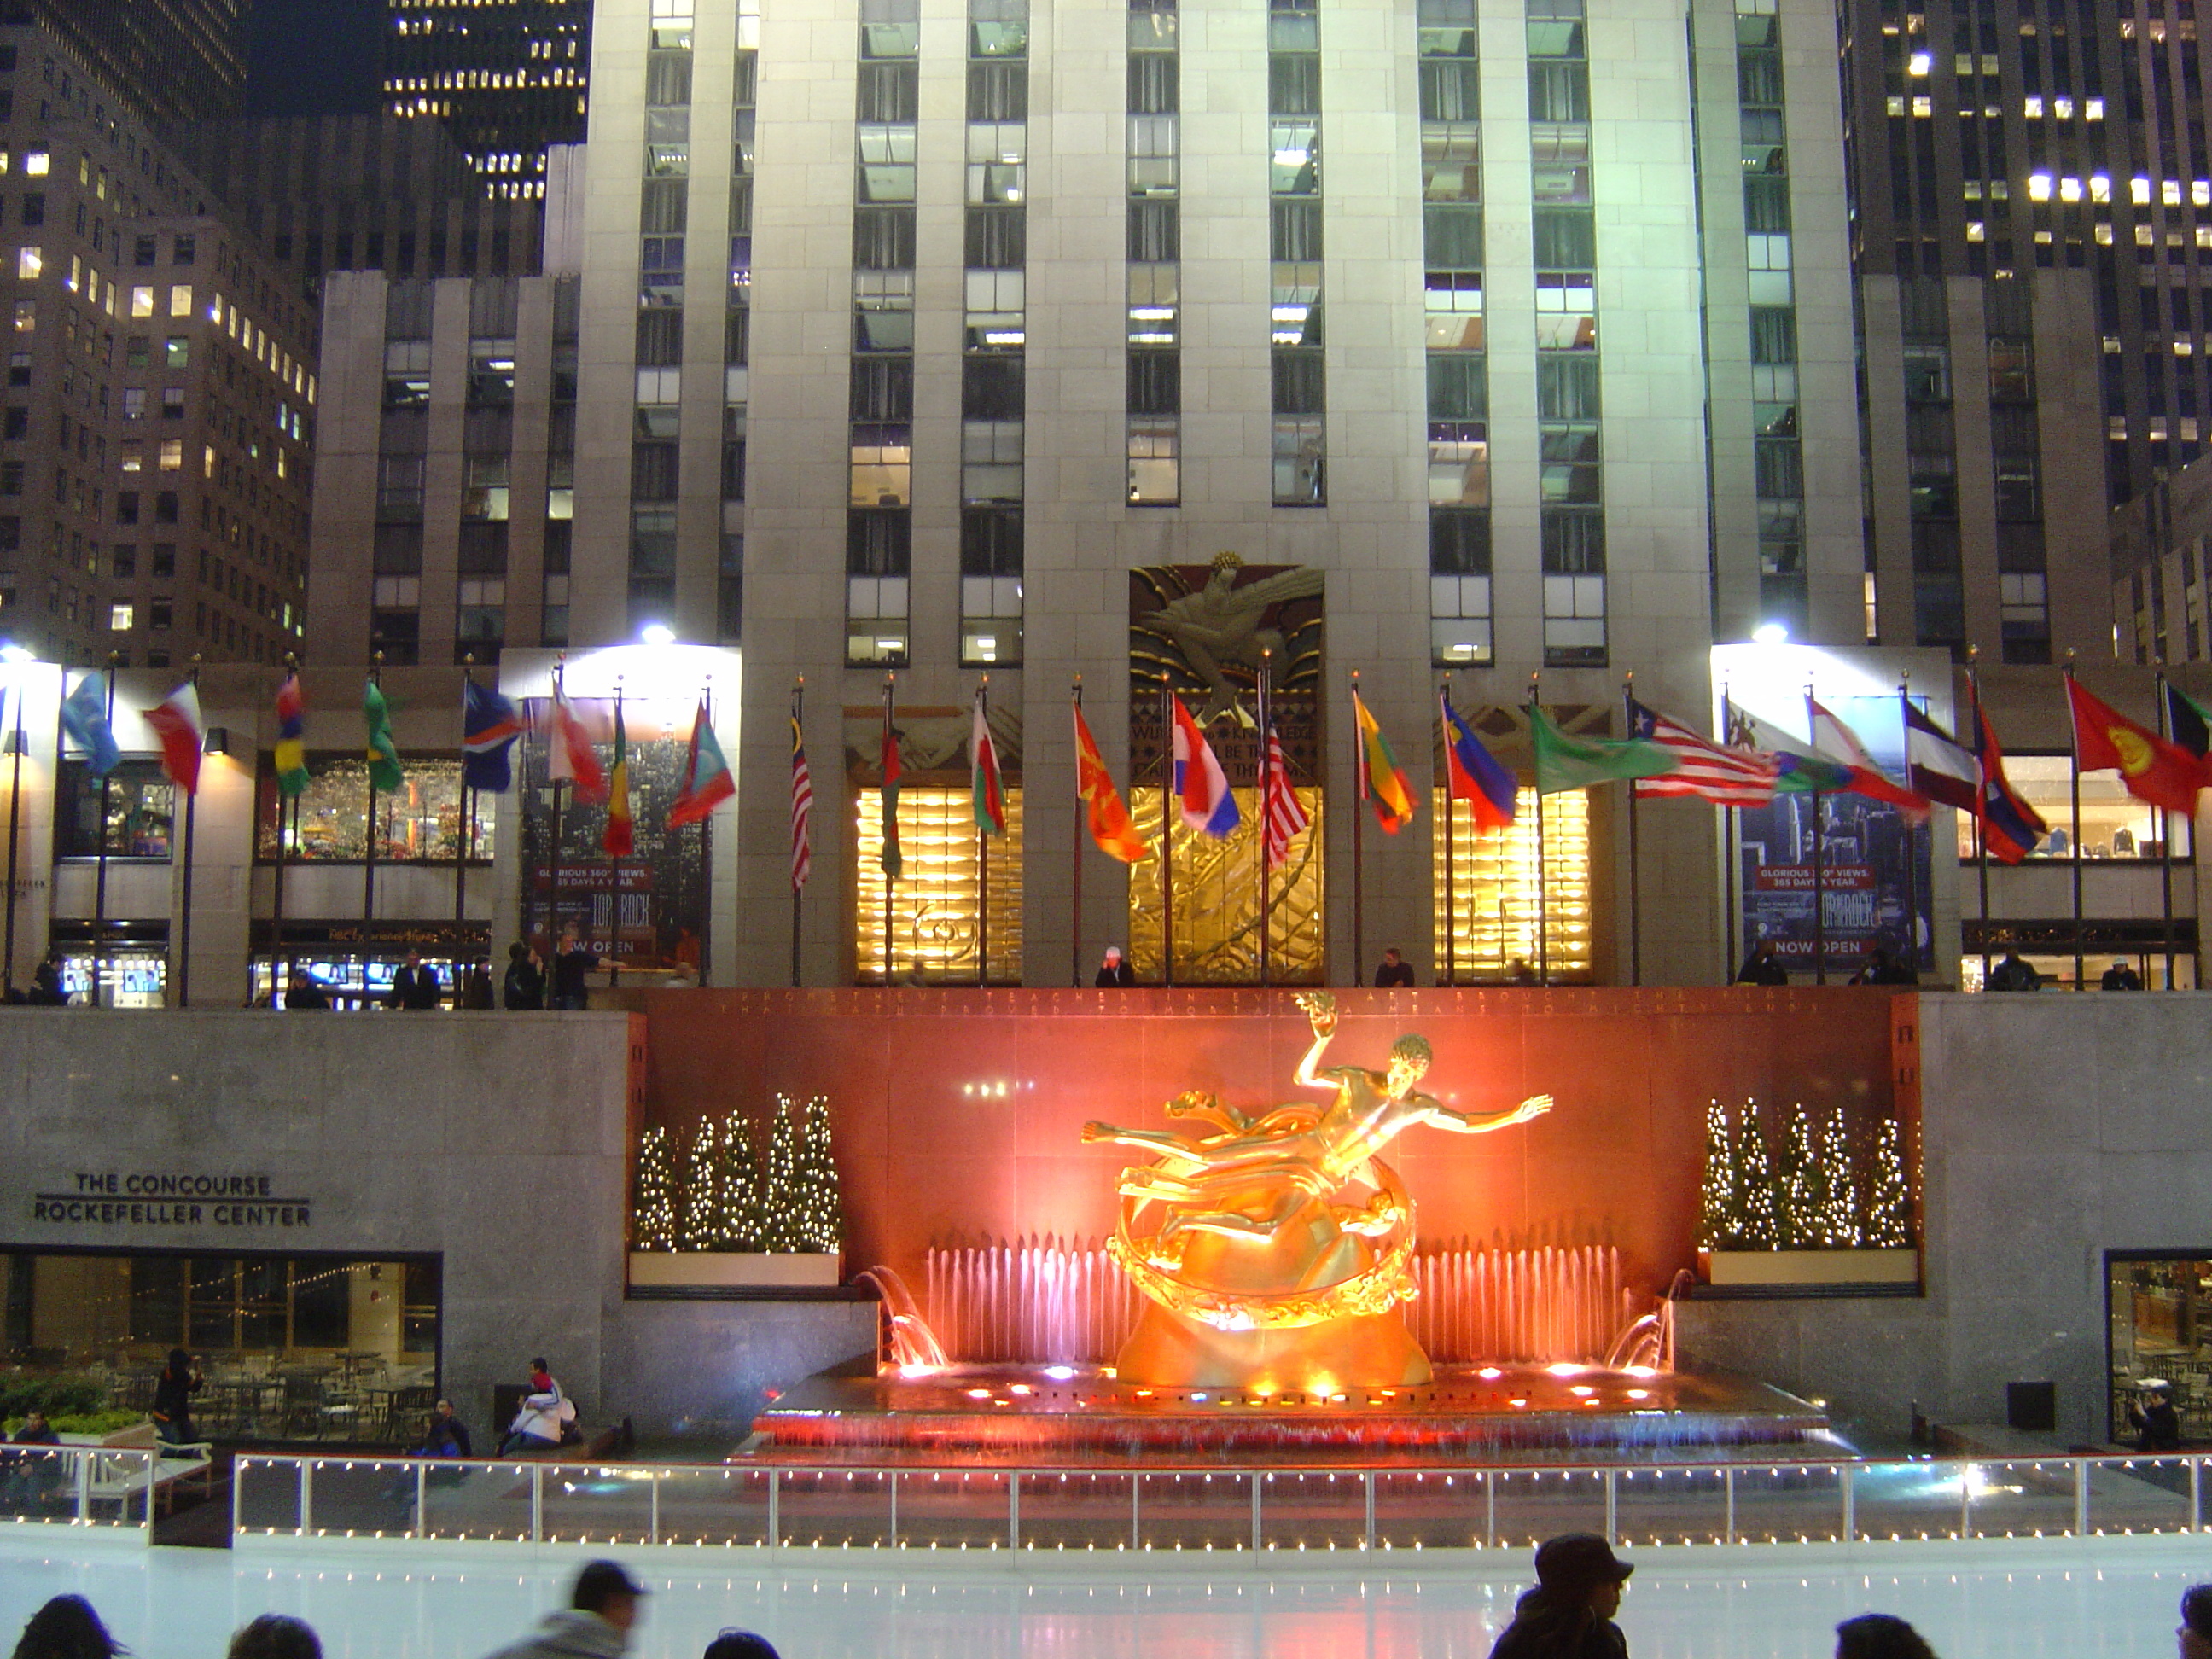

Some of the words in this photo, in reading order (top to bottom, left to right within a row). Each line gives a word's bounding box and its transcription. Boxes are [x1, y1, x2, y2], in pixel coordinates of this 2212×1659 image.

[1761, 869, 1809, 877] GLORIOUS
[1773, 878, 1790, 887] 365
[592, 894, 613, 927] TOP
[620, 894, 650, 927] ROCK
[1822, 894, 1836, 927] OP
[1844, 894, 1875, 927] ROCK
[1776, 941, 1813, 952] NOW
[987, 992, 1127, 1002] TEACHER
[1167, 992, 1195, 1002] IN
[1367, 992, 1418, 1001] ART
[941, 1005, 1059, 1015] PROVED
[1098, 1005, 1128, 1015] TO
[1164, 1005, 1284, 1015] MORTAL
[1389, 1005, 1486, 1014] MEANS
[1524, 1005, 1553, 1014] TO
[75, 1173, 118, 1192] THE
[127, 1174, 270, 1195] CONCOURSE
[34, 1202, 201, 1225] ROCKEFELLER
[214, 1204, 310, 1226] CENTER
